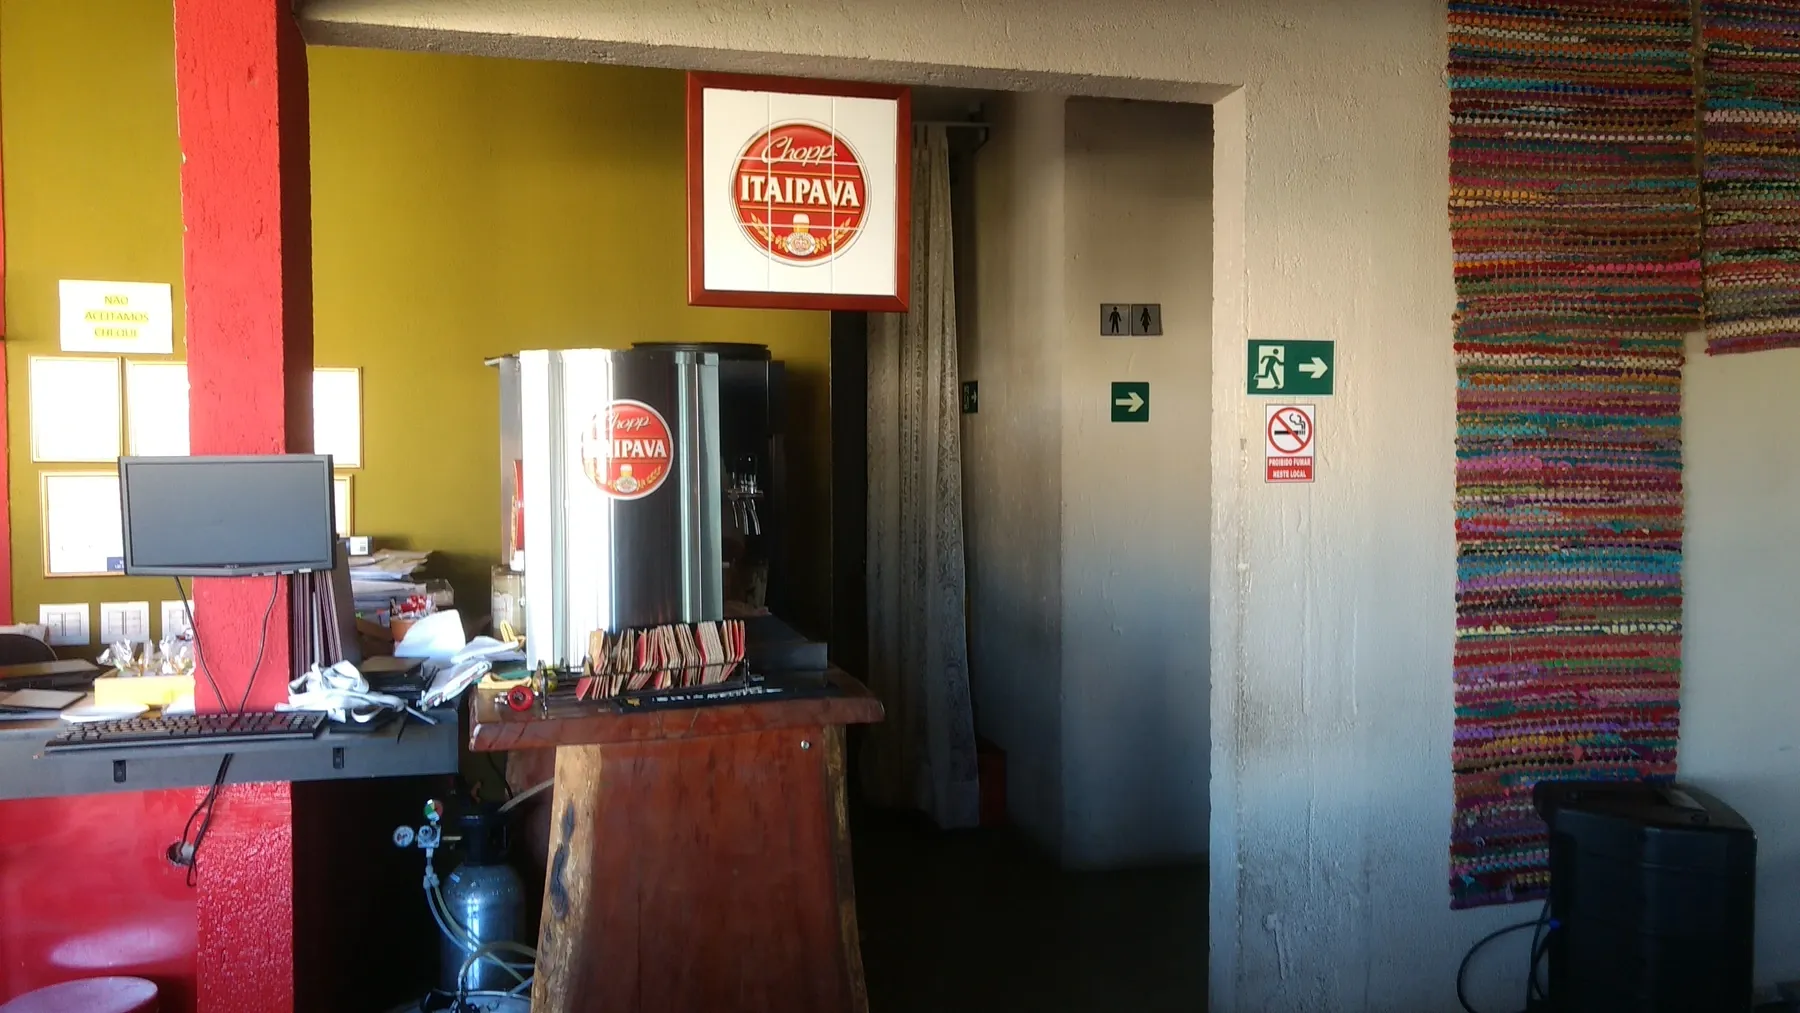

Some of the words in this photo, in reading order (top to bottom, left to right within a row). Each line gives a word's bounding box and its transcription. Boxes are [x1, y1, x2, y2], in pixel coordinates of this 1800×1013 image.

[761, 135, 838, 167] Chopp
[741, 174, 860, 207] ITAIPAVA
[609, 411, 651, 432] hopp
[1268, 457, 1293, 467] PROIBIDO
[1293, 458, 1311, 467] FUMAR
[1272, 469, 1290, 478] NESTE
[1290, 469, 1307, 478] LOCAL
